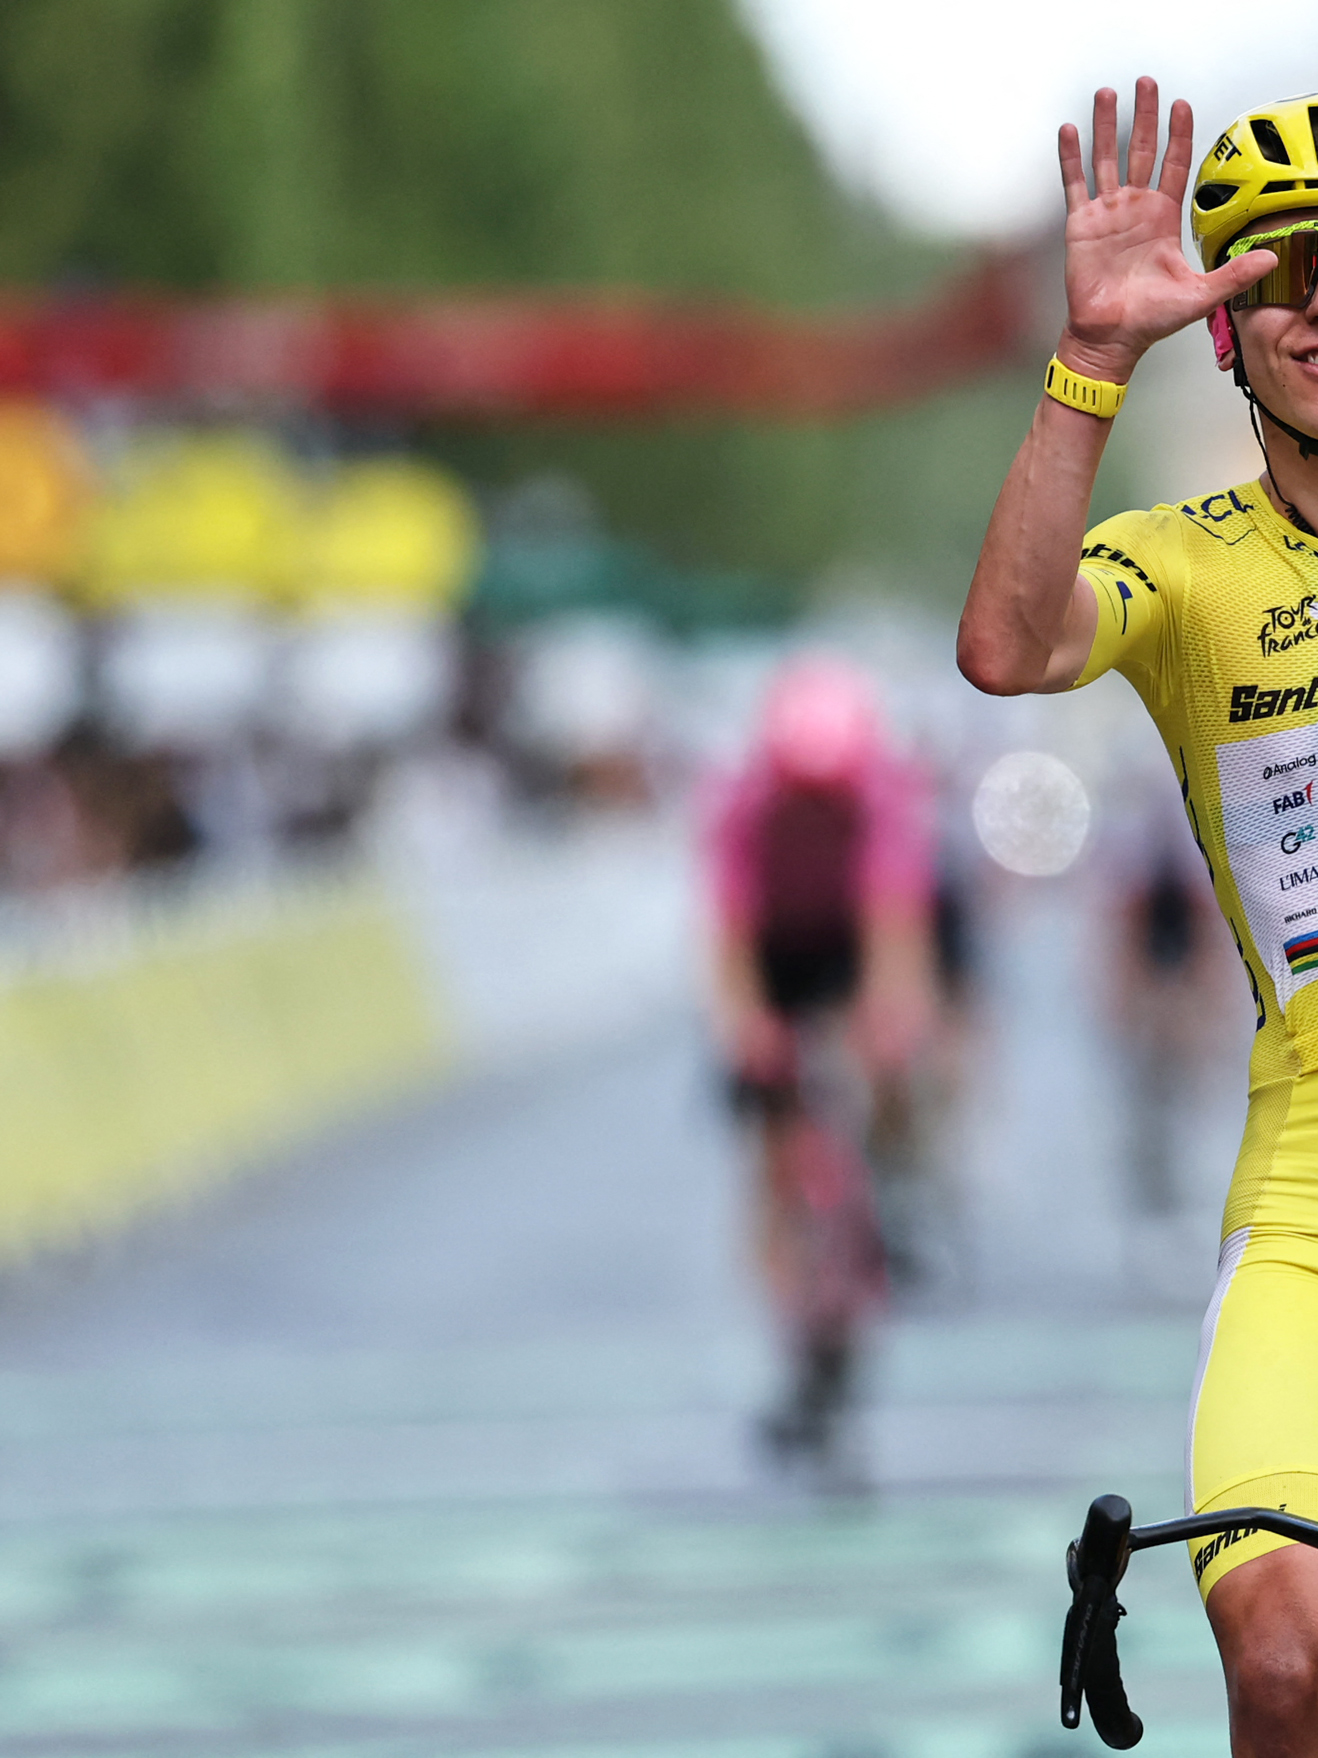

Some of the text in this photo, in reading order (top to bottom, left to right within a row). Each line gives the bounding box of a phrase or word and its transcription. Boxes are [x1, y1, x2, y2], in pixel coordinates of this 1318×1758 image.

[1274, 754, 1316, 776] Analog
[1281, 824, 1316, 854] G42
[1284, 907, 1318, 924] RICHARD
